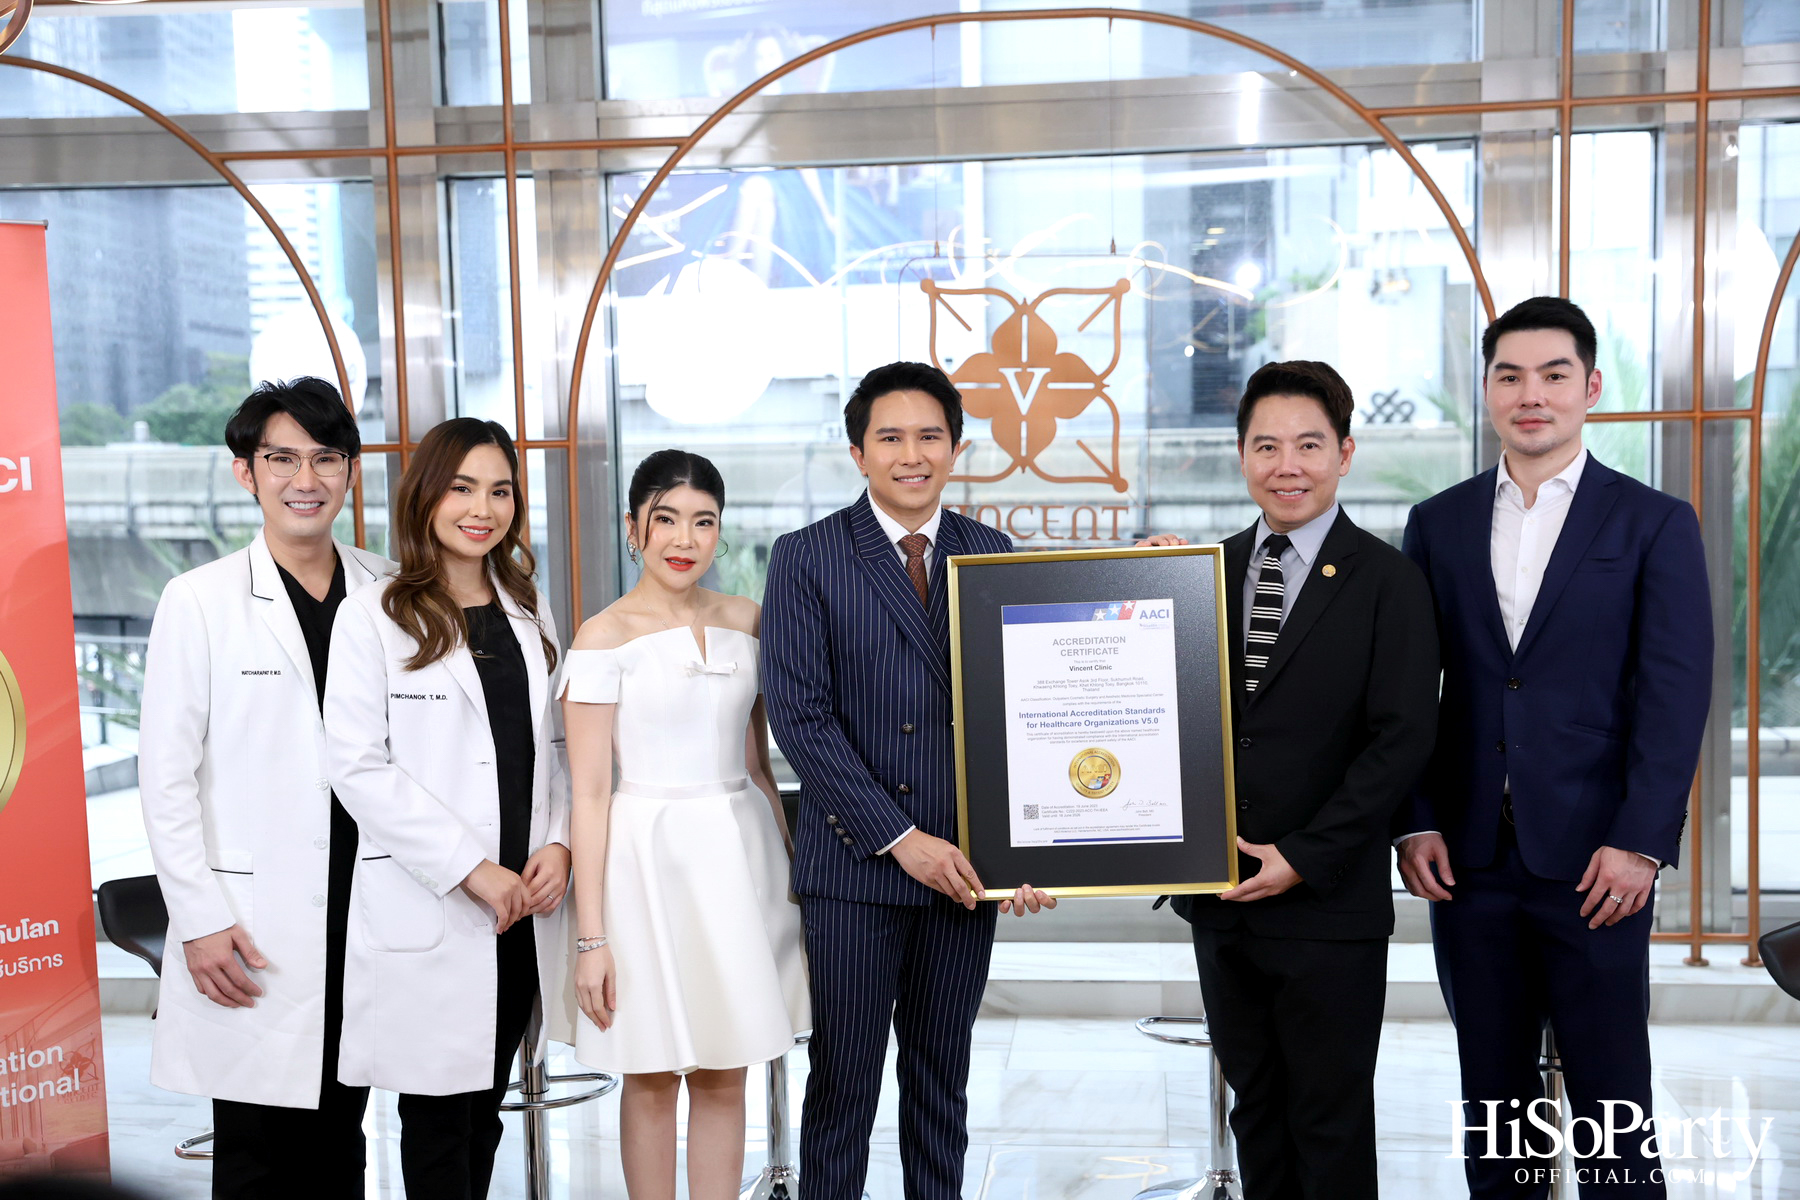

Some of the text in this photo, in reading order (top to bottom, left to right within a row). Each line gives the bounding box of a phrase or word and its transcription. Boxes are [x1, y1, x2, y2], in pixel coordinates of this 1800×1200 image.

[1139, 609, 1170, 620] AACI
[1052, 636, 1126, 646] ACCREDITATION
[1060, 647, 1119, 657] CERTIFICATE
[1018, 706, 1166, 719] International Accreditation Standards
[1026, 717, 1159, 729] for Healthcare Organizations V5.0
